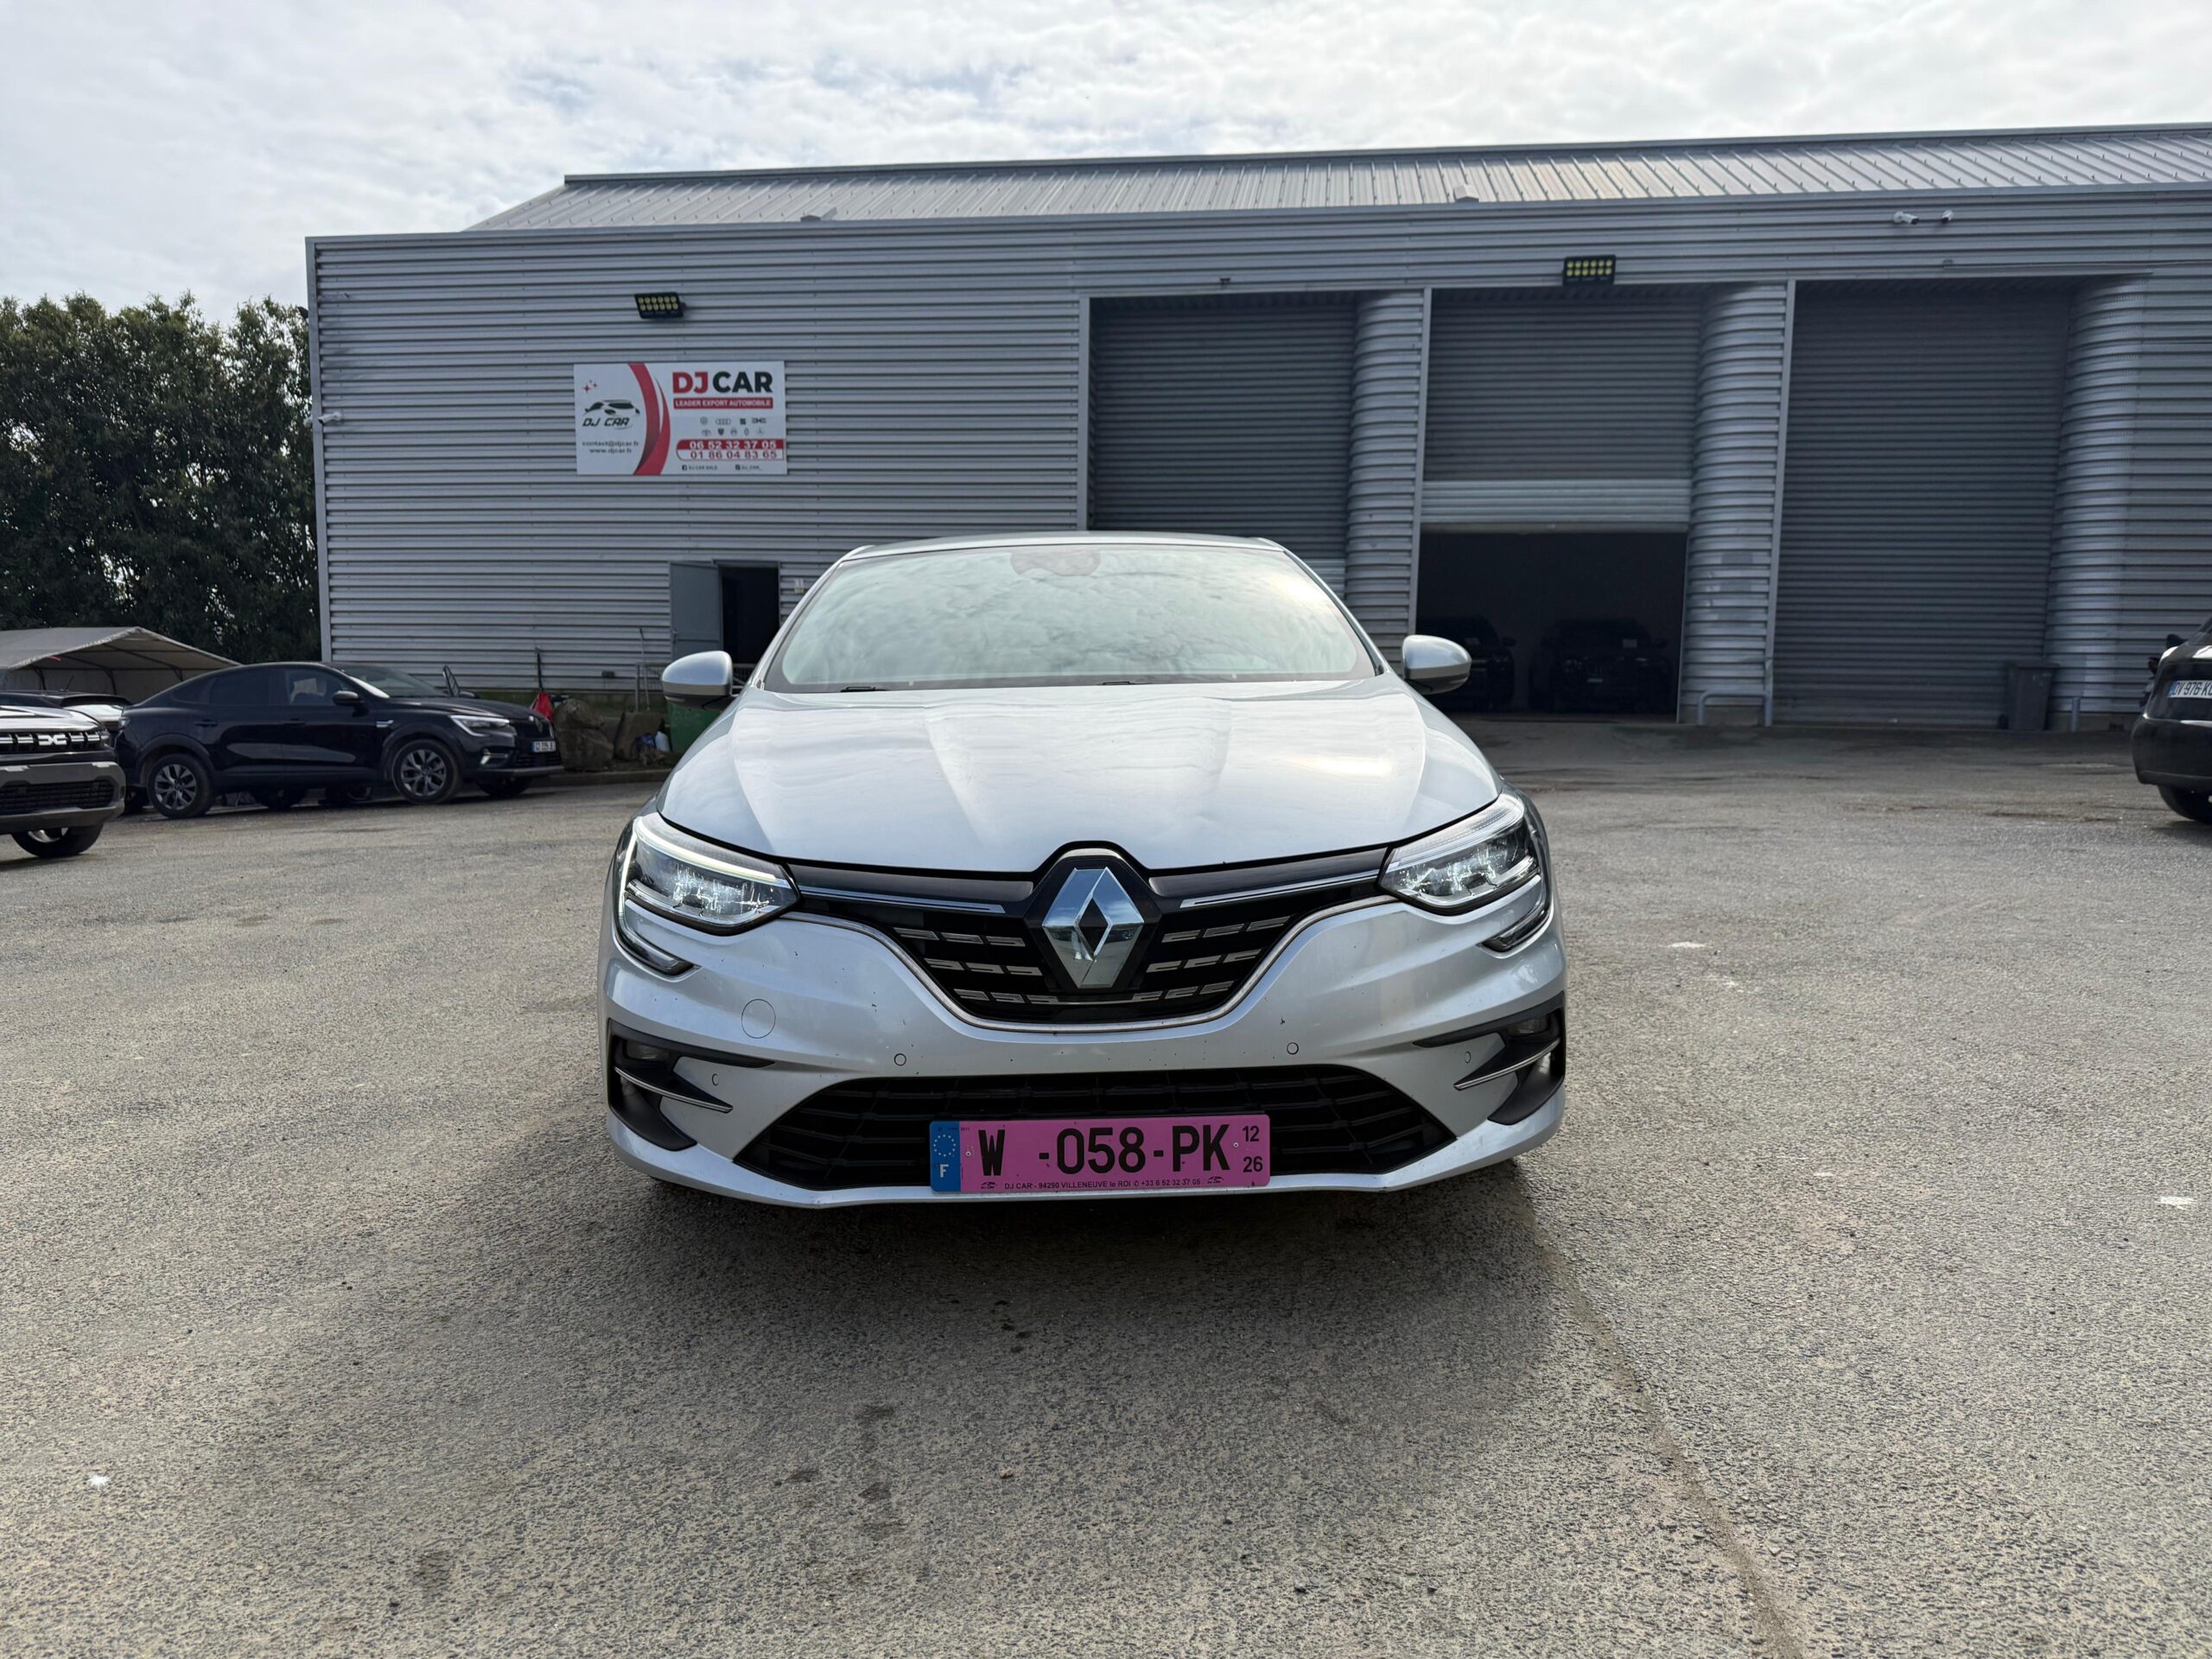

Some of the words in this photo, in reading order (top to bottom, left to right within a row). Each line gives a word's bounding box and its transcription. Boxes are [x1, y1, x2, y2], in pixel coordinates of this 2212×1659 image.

[672, 372, 709, 394] DJ
[712, 371, 773, 394] CAR
[582, 417, 601, 427] DJ
[604, 417, 630, 427] CAR
[690, 441, 704, 449] 06
[709, 441, 721, 449] 52
[726, 441, 740, 449] 32
[744, 441, 758, 449] 37
[761, 441, 776, 449] 05
[690, 450, 703, 459] 01
[709, 450, 722, 459] 86
[727, 450, 741, 459] 04
[744, 450, 759, 459] 83
[762, 450, 777, 459] 65
[1243, 1125, 1260, 1142] 12
[978, 1128, 1006, 1176] W
[939, 1163, 950, 1178] F
[1243, 1156, 1263, 1173] 26
[1061, 1180, 1108, 1189] VILLENEUVE
